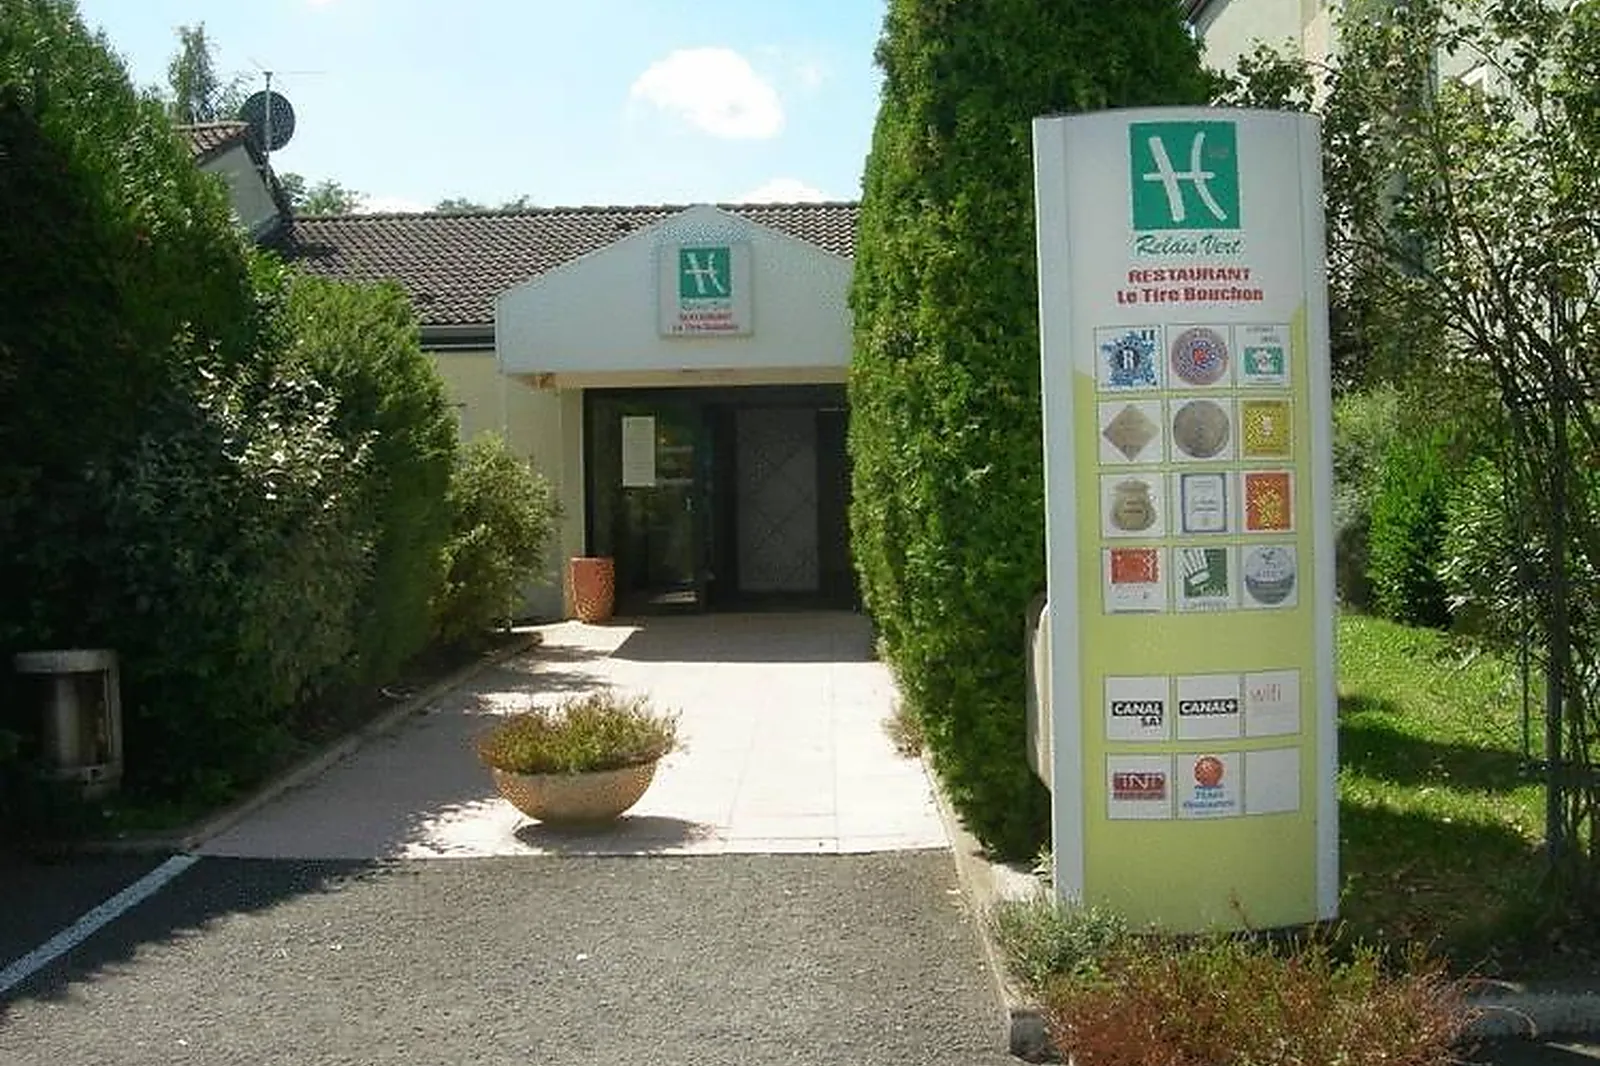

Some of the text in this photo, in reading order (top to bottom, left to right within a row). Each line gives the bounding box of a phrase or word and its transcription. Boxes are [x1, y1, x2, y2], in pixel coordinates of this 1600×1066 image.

[1135, 234, 1242, 256] Relais Vert
[1128, 267, 1250, 284] RESTAURANT
[1117, 286, 1263, 303] Le Tire Bouchon
[1113, 702, 1162, 716] CANAL
[1180, 700, 1237, 715] CANAL+
